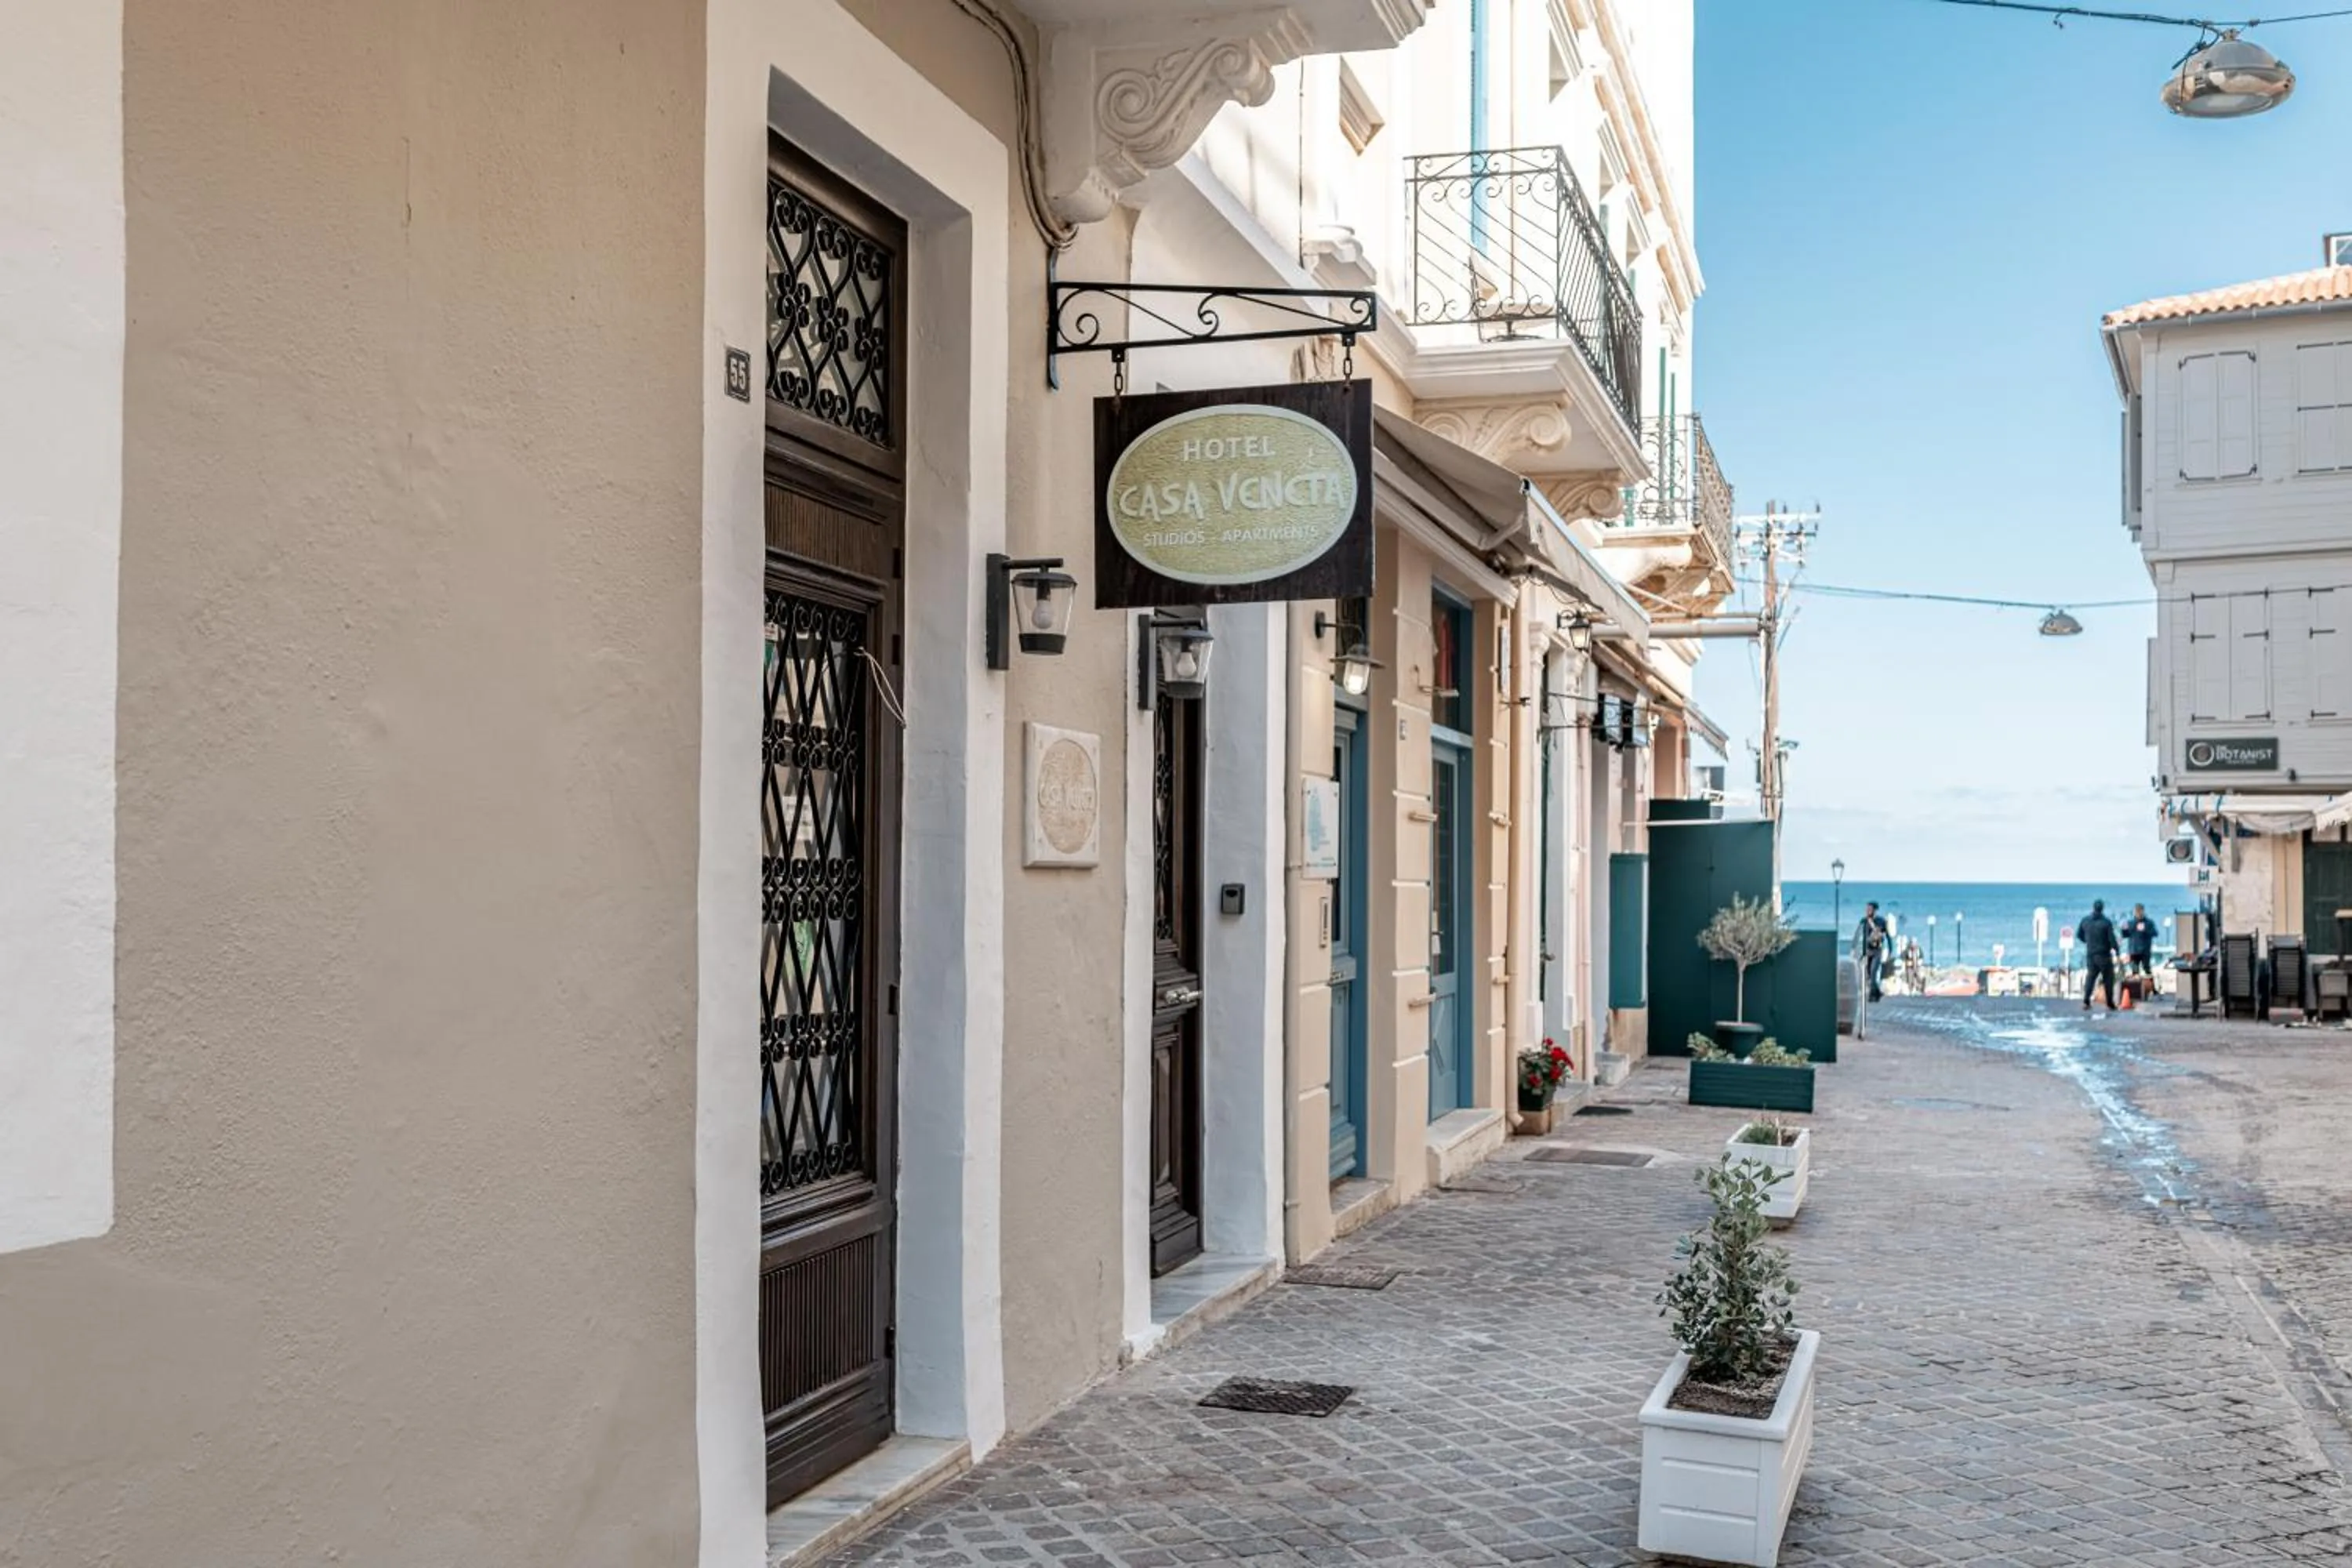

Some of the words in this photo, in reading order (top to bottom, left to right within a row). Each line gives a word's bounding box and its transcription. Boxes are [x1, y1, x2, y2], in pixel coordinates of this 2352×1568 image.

[730, 357, 746, 390] 55
[1182, 436, 1276, 463] HOTEL
[1120, 482, 1205, 521] CASA
[1217, 470, 1346, 512] VENETA
[1142, 530, 1205, 548] STUDIOS
[1221, 524, 1319, 543] APARTMENTS
